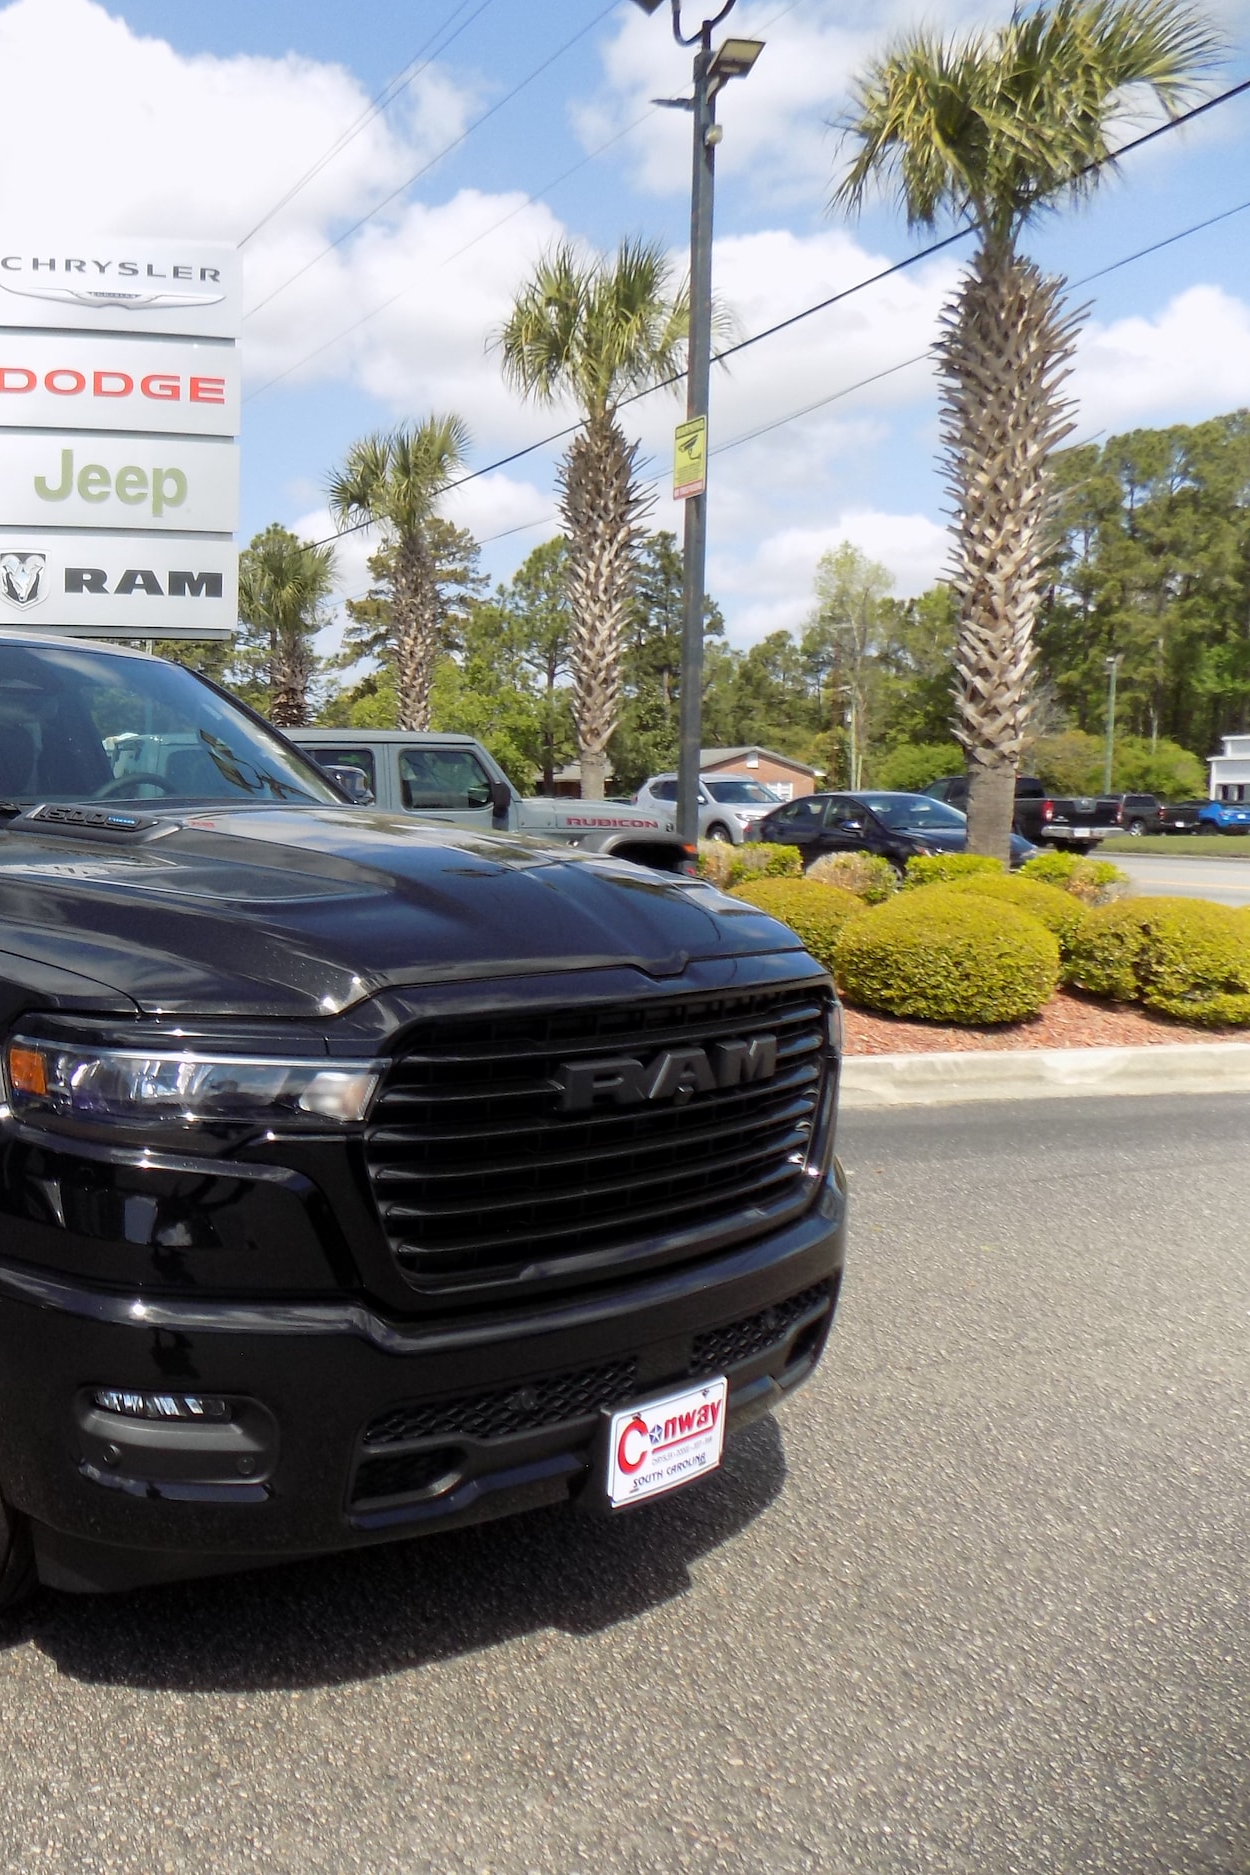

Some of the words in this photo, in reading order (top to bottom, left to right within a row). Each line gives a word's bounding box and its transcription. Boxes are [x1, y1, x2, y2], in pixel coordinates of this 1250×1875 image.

[0, 256, 221, 284] CHRYSLER
[33, 448, 188, 517] Jeep
[64, 567, 223, 598] RAM
[565, 816, 659, 829] RUBICON
[554, 1032, 778, 1112] RAM
[632, 1469, 664, 1489] SOUTH
[666, 1452, 707, 1477] CAROLINA
